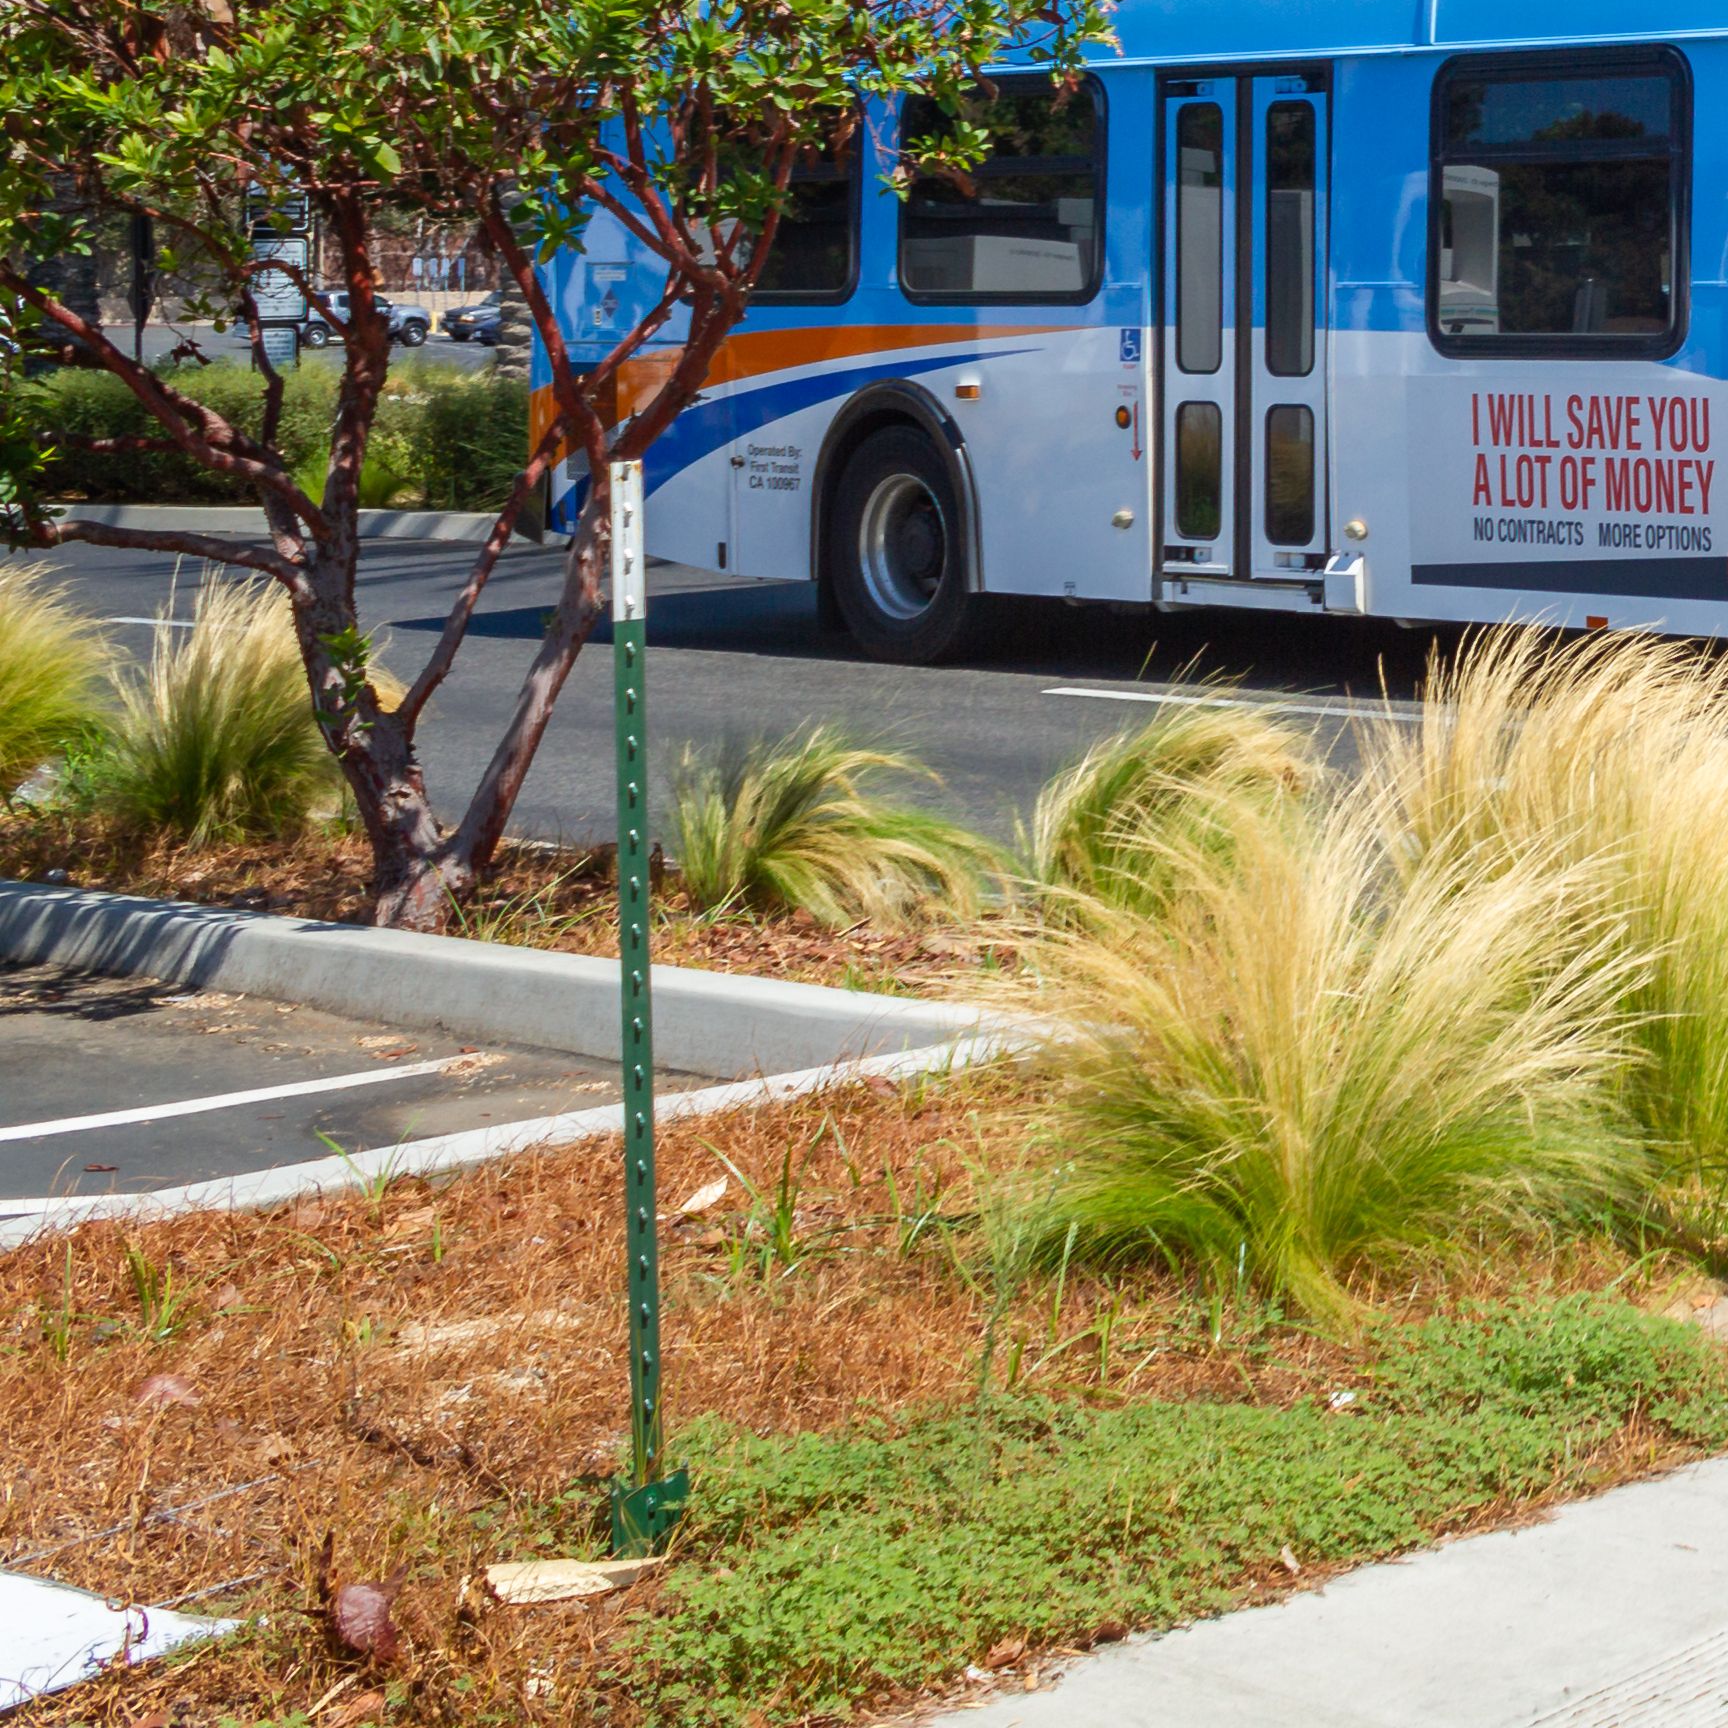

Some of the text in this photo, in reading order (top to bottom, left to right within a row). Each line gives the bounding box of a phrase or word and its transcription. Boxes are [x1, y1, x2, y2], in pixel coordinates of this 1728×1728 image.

[1472, 393, 1710, 452] I WILL SAVE YOU
[749, 475, 764, 489] CA
[1473, 453, 1715, 515] A LOT OF MONEY
[1474, 517, 1712, 552] NO CONTRACTS MORE OPTIONS
